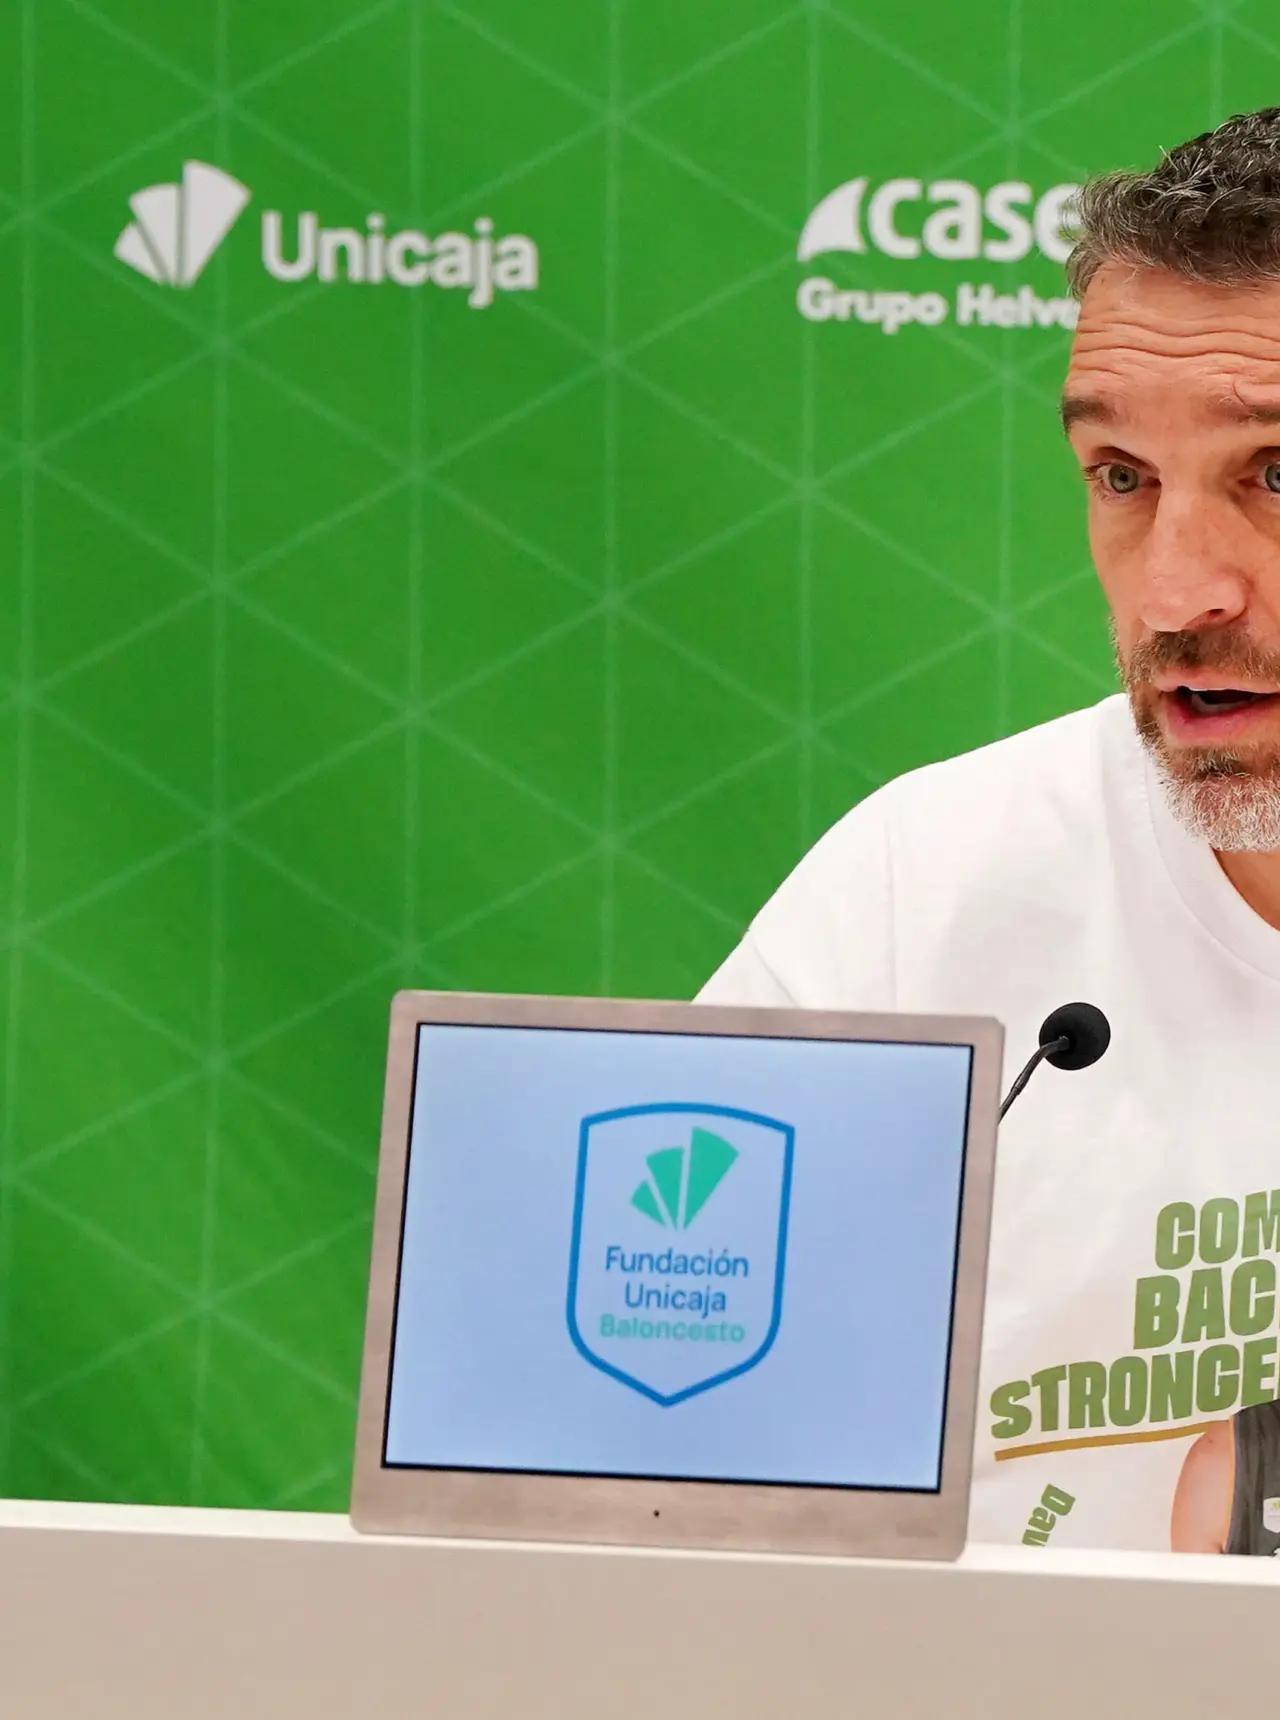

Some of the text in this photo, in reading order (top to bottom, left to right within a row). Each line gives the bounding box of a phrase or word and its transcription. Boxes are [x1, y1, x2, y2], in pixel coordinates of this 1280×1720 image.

[867, 177, 1086, 264] case
[261, 209, 539, 310] Unicaja
[796, 276, 1082, 335] Grupo Helve
[605, 1245, 750, 1278] Fundación
[624, 1280, 727, 1320] Unicaja
[600, 1312, 746, 1344] Baloncesto
